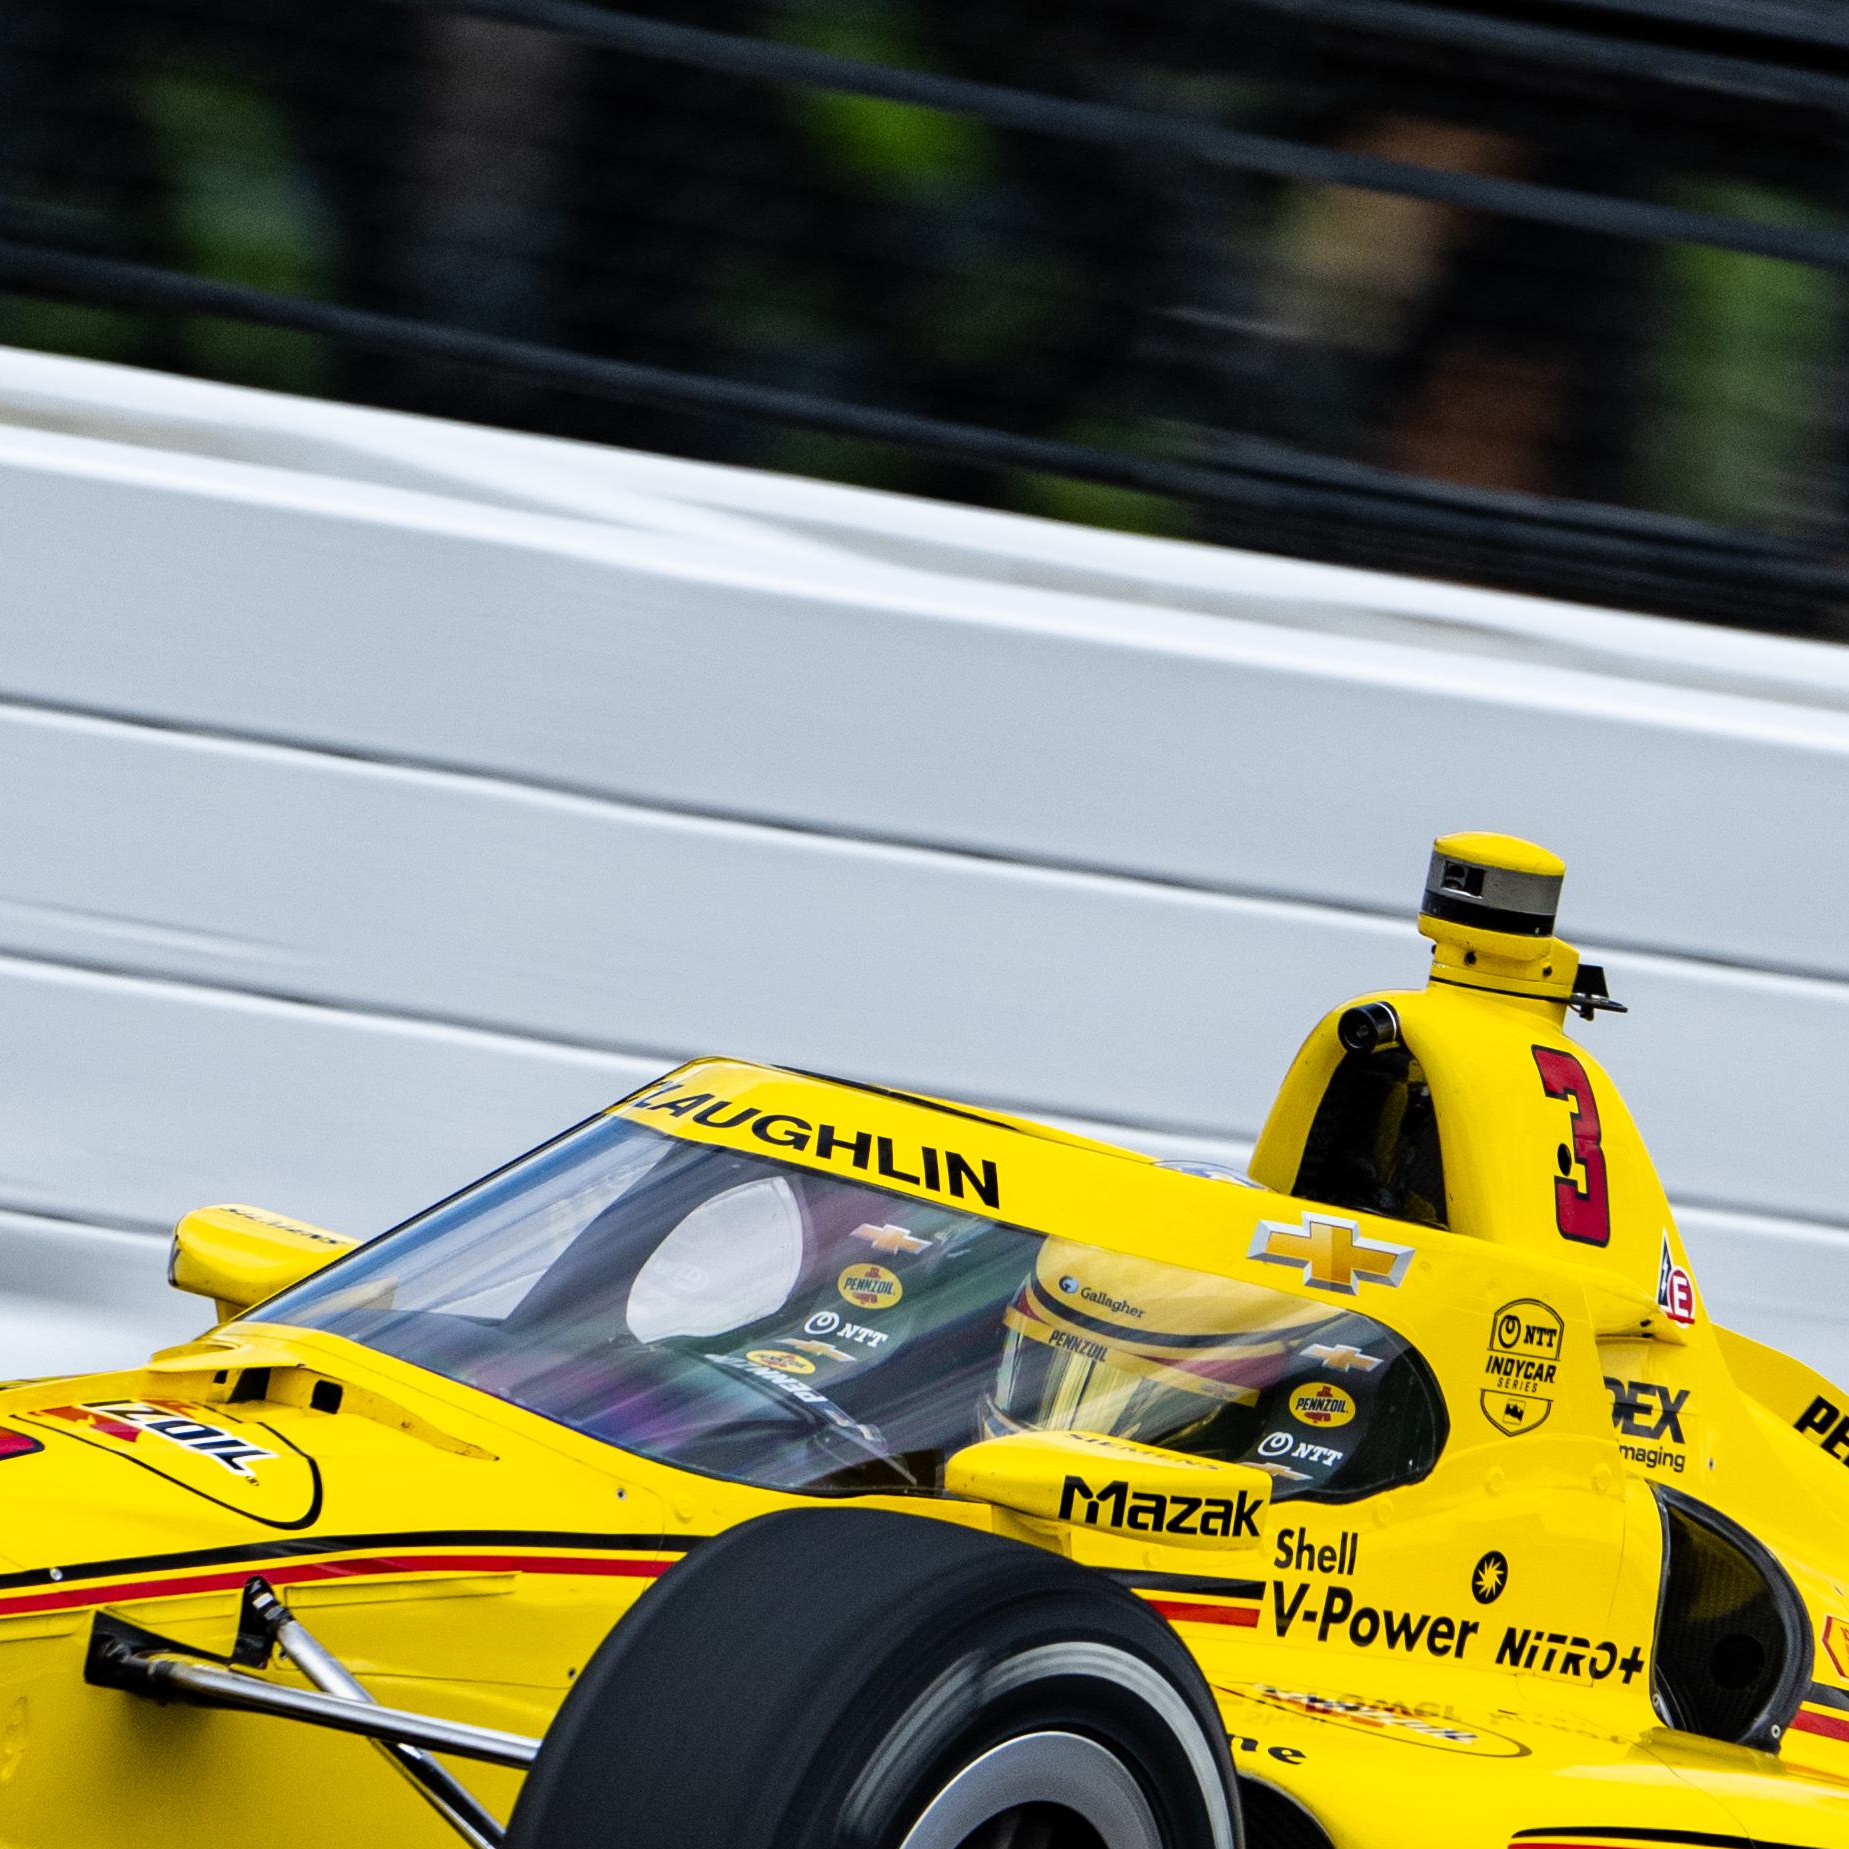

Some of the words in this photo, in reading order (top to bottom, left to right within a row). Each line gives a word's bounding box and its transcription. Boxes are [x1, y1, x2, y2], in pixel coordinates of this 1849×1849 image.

[629, 1081, 1000, 1209] LAUGHLIN
[1531, 1044, 1610, 1248] 3
[844, 1276, 892, 1296] PENNZOIL
[1080, 1286, 1146, 1319] Gallagher
[837, 1322, 889, 1348] NTT
[1048, 1328, 1109, 1363] PENNZOIL
[1523, 1324, 1558, 1348] NTT
[1485, 1355, 1557, 1384] INDYCAR
[1496, 1377, 1539, 1394] SERIES
[1295, 1396, 1347, 1414] PENNZOIL
[1291, 1442, 1344, 1467] NTT
[1618, 1443, 1686, 1474] maging
[1058, 1474, 1264, 1538] Mazak
[1274, 1526, 1359, 1576] Shell
[1272, 1579, 1480, 1660] V-Power
